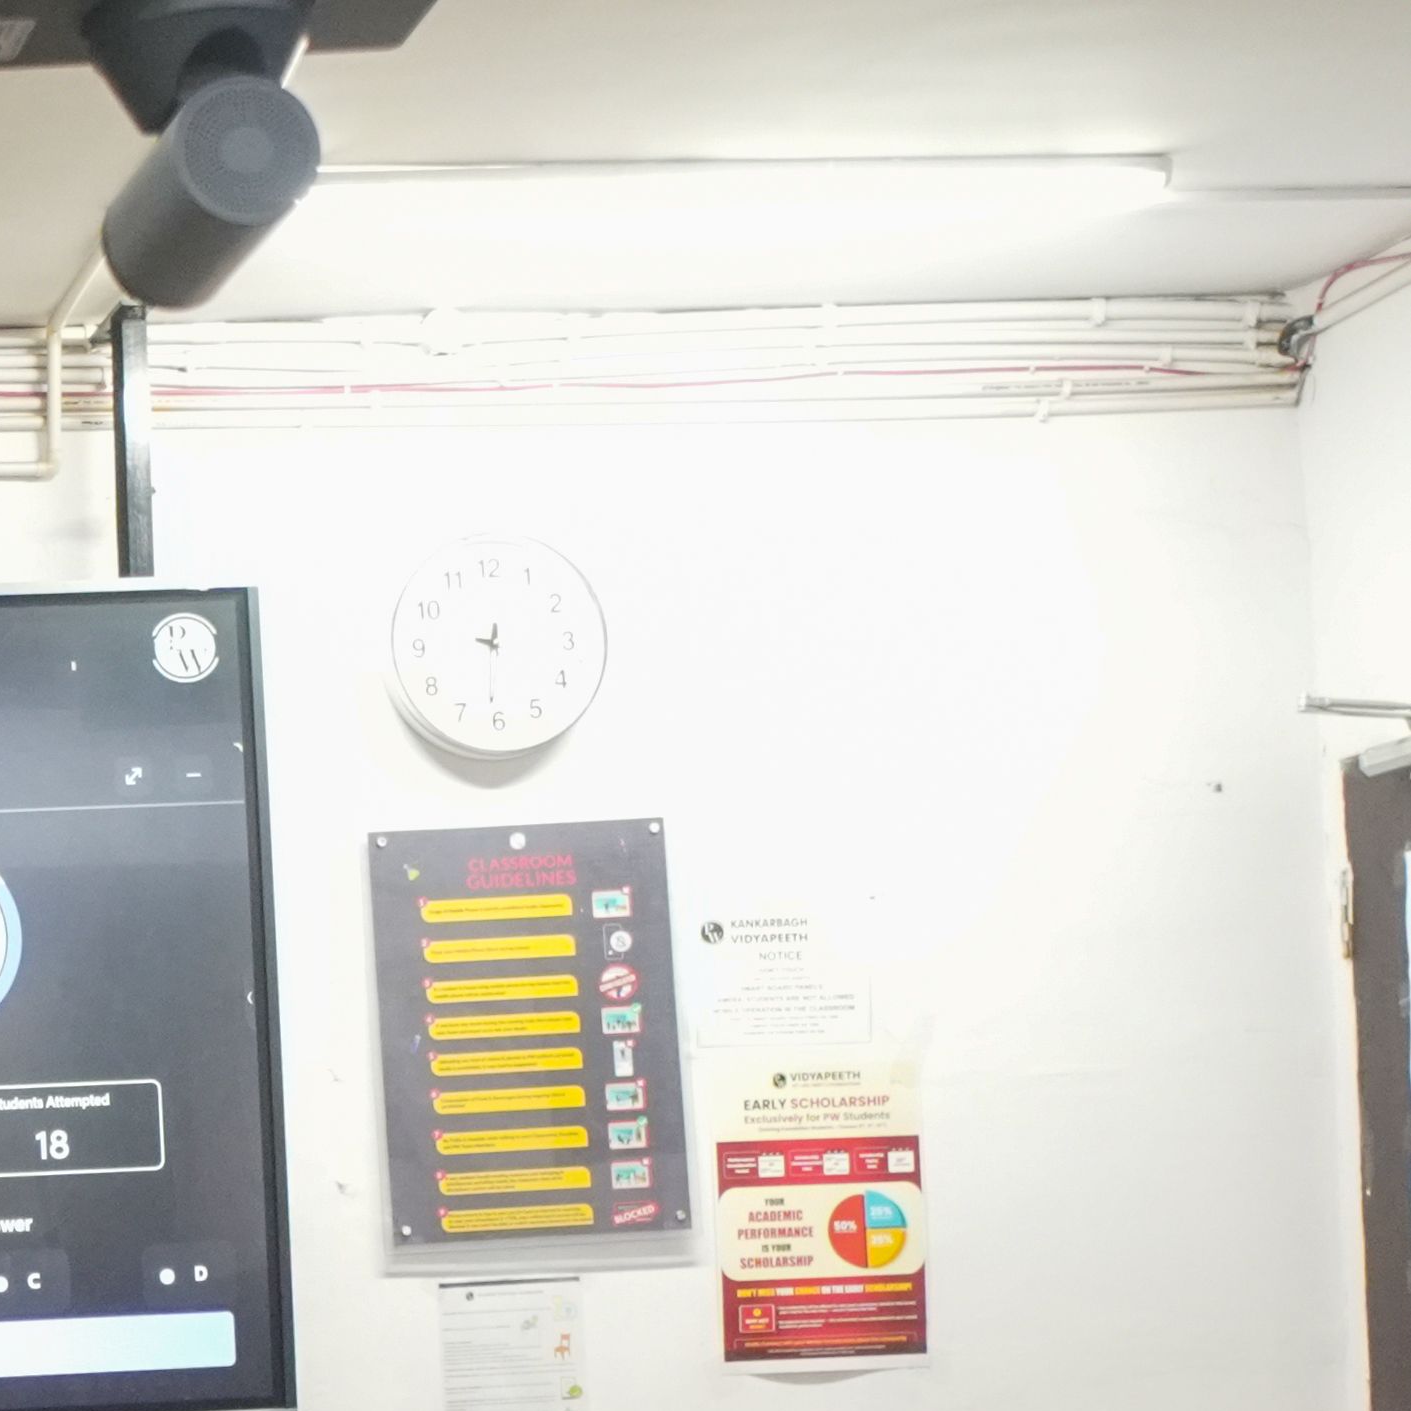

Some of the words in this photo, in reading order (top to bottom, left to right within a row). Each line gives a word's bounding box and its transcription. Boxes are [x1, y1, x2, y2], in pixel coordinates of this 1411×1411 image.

[479, 559, 500, 578] 12
[444, 571, 462, 590] 11
[418, 600, 440, 620] 10
[550, 593, 562, 613] 2
[412, 638, 425, 658] 9
[563, 631, 575, 651] 3
[426, 676, 438, 696] 8
[555, 669, 567, 688] 4
[454, 703, 467, 722] 7
[529, 699, 543, 718] 5
[492, 711, 506, 731] 6
[468, 854, 573, 873] CLASSROOM
[466, 870, 577, 890] GUIDELINES
[730, 917, 808, 929] KANKARBAGH
[730, 932, 808, 944] VIDYAPEETH
[759, 950, 803, 961] NOTICE
[790, 1071, 861, 1082] VIDYAPEETH
[45, 1092, 110, 1111] Attempted
[744, 1098, 786, 1111] EARLY
[790, 1095, 890, 1109] SCHOLARSHIP
[744, 1112, 803, 1125] Exclusively
[806, 1113, 820, 1122] for
[823, 1112, 840, 1121] PW
[843, 1110, 891, 1121] Students
[35, 1129, 70, 1161] 18
[765, 1197, 785, 1206] YOUR
[748, 1209, 803, 1223] ACADEMIC
[737, 1226, 814, 1240] PERFORMANCE
[762, 1245, 769, 1253] IS
[772, 1243, 791, 1253] YOUR
[740, 1255, 814, 1270] SCHOLARSHIP
[26, 1272, 41, 1290] C
[193, 1264, 209, 1282] D
